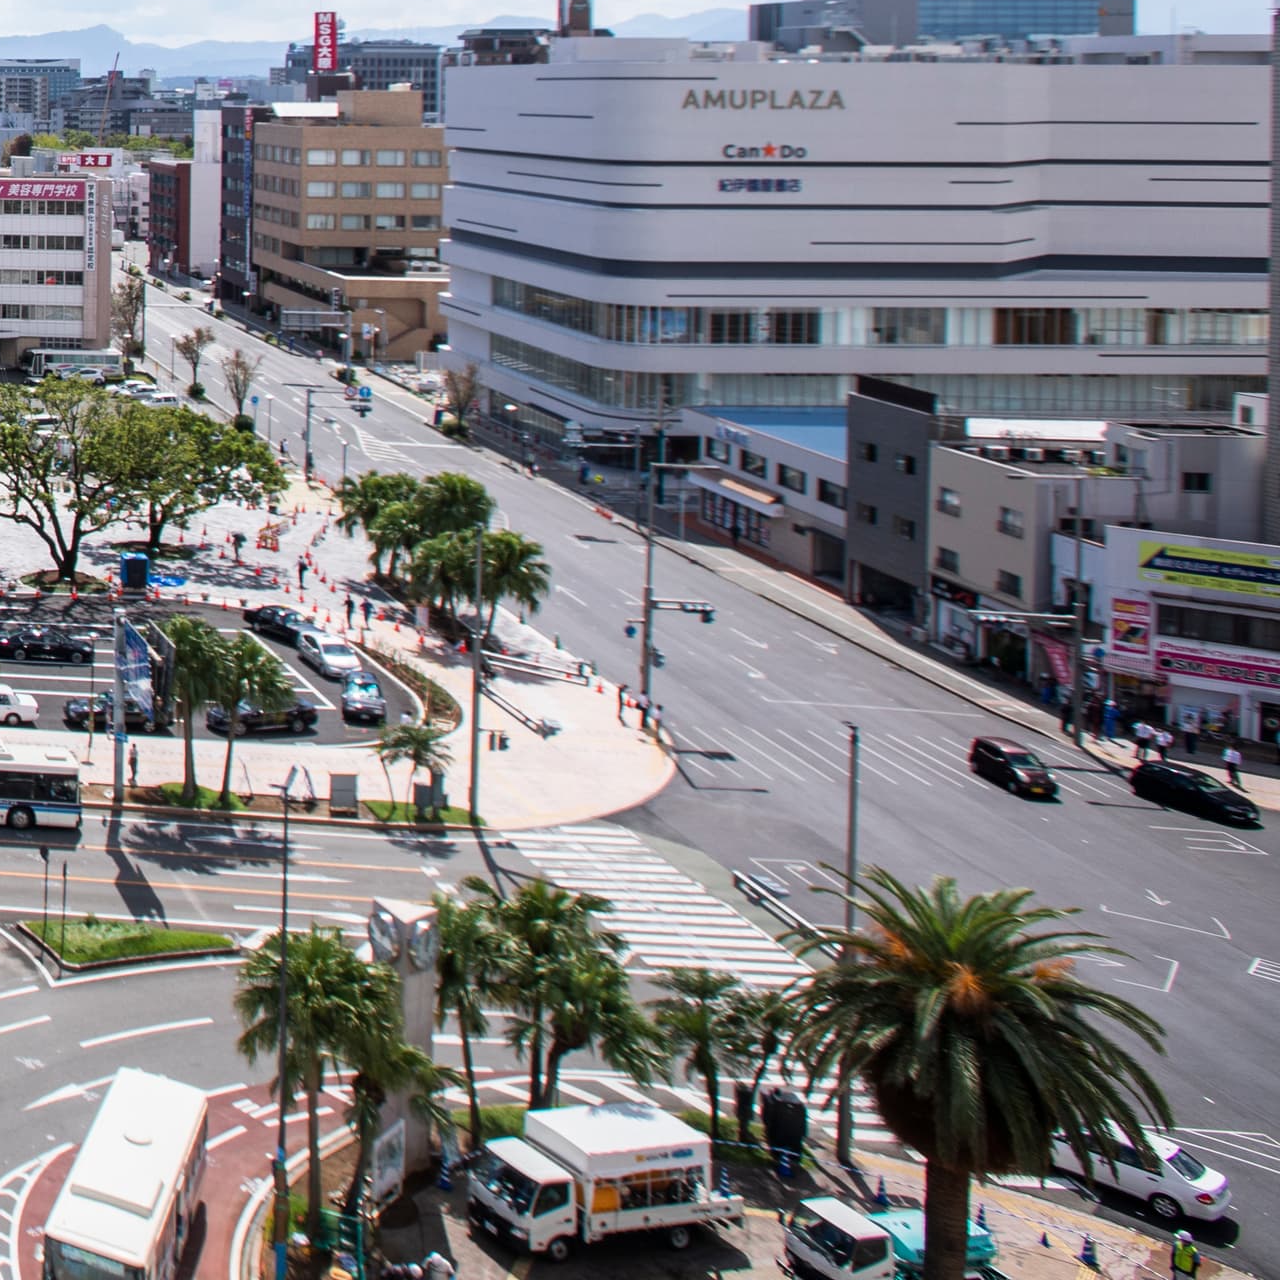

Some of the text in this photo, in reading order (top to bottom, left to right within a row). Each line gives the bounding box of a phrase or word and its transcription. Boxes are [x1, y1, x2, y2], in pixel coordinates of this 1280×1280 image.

[682, 89, 845, 110] AMUPLAZA
[8, 184, 78, 198] 美容専門学校
